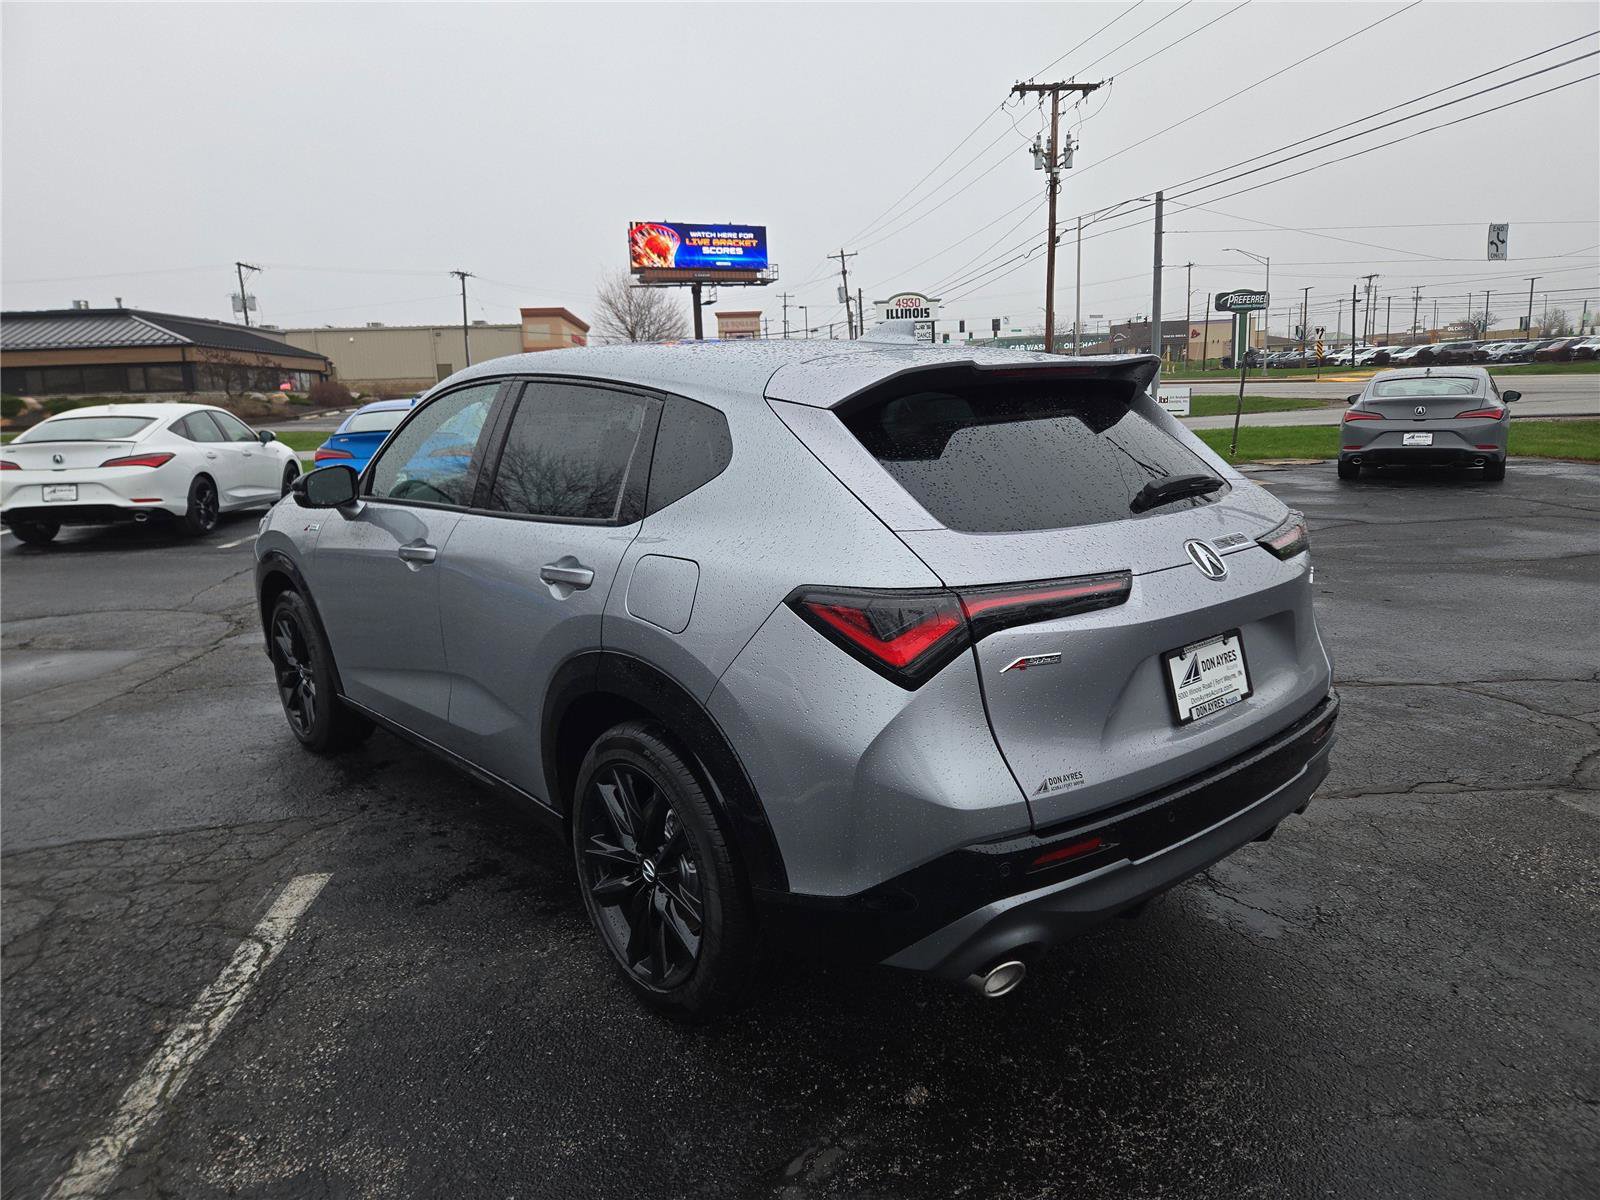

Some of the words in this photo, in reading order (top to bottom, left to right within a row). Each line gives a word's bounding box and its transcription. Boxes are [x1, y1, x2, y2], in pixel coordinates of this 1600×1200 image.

[712, 239, 758, 247] BRACKET
[895, 298, 921, 308] 4930
[886, 308, 930, 319] ILLINOIS
[1201, 656, 1217, 672] DON
[1216, 649, 1237, 667] AYRES
[1196, 703, 1208, 717] DON
[1207, 697, 1226, 713] AYRES
[1048, 775, 1063, 786] DON
[1062, 770, 1083, 782] AYRES
